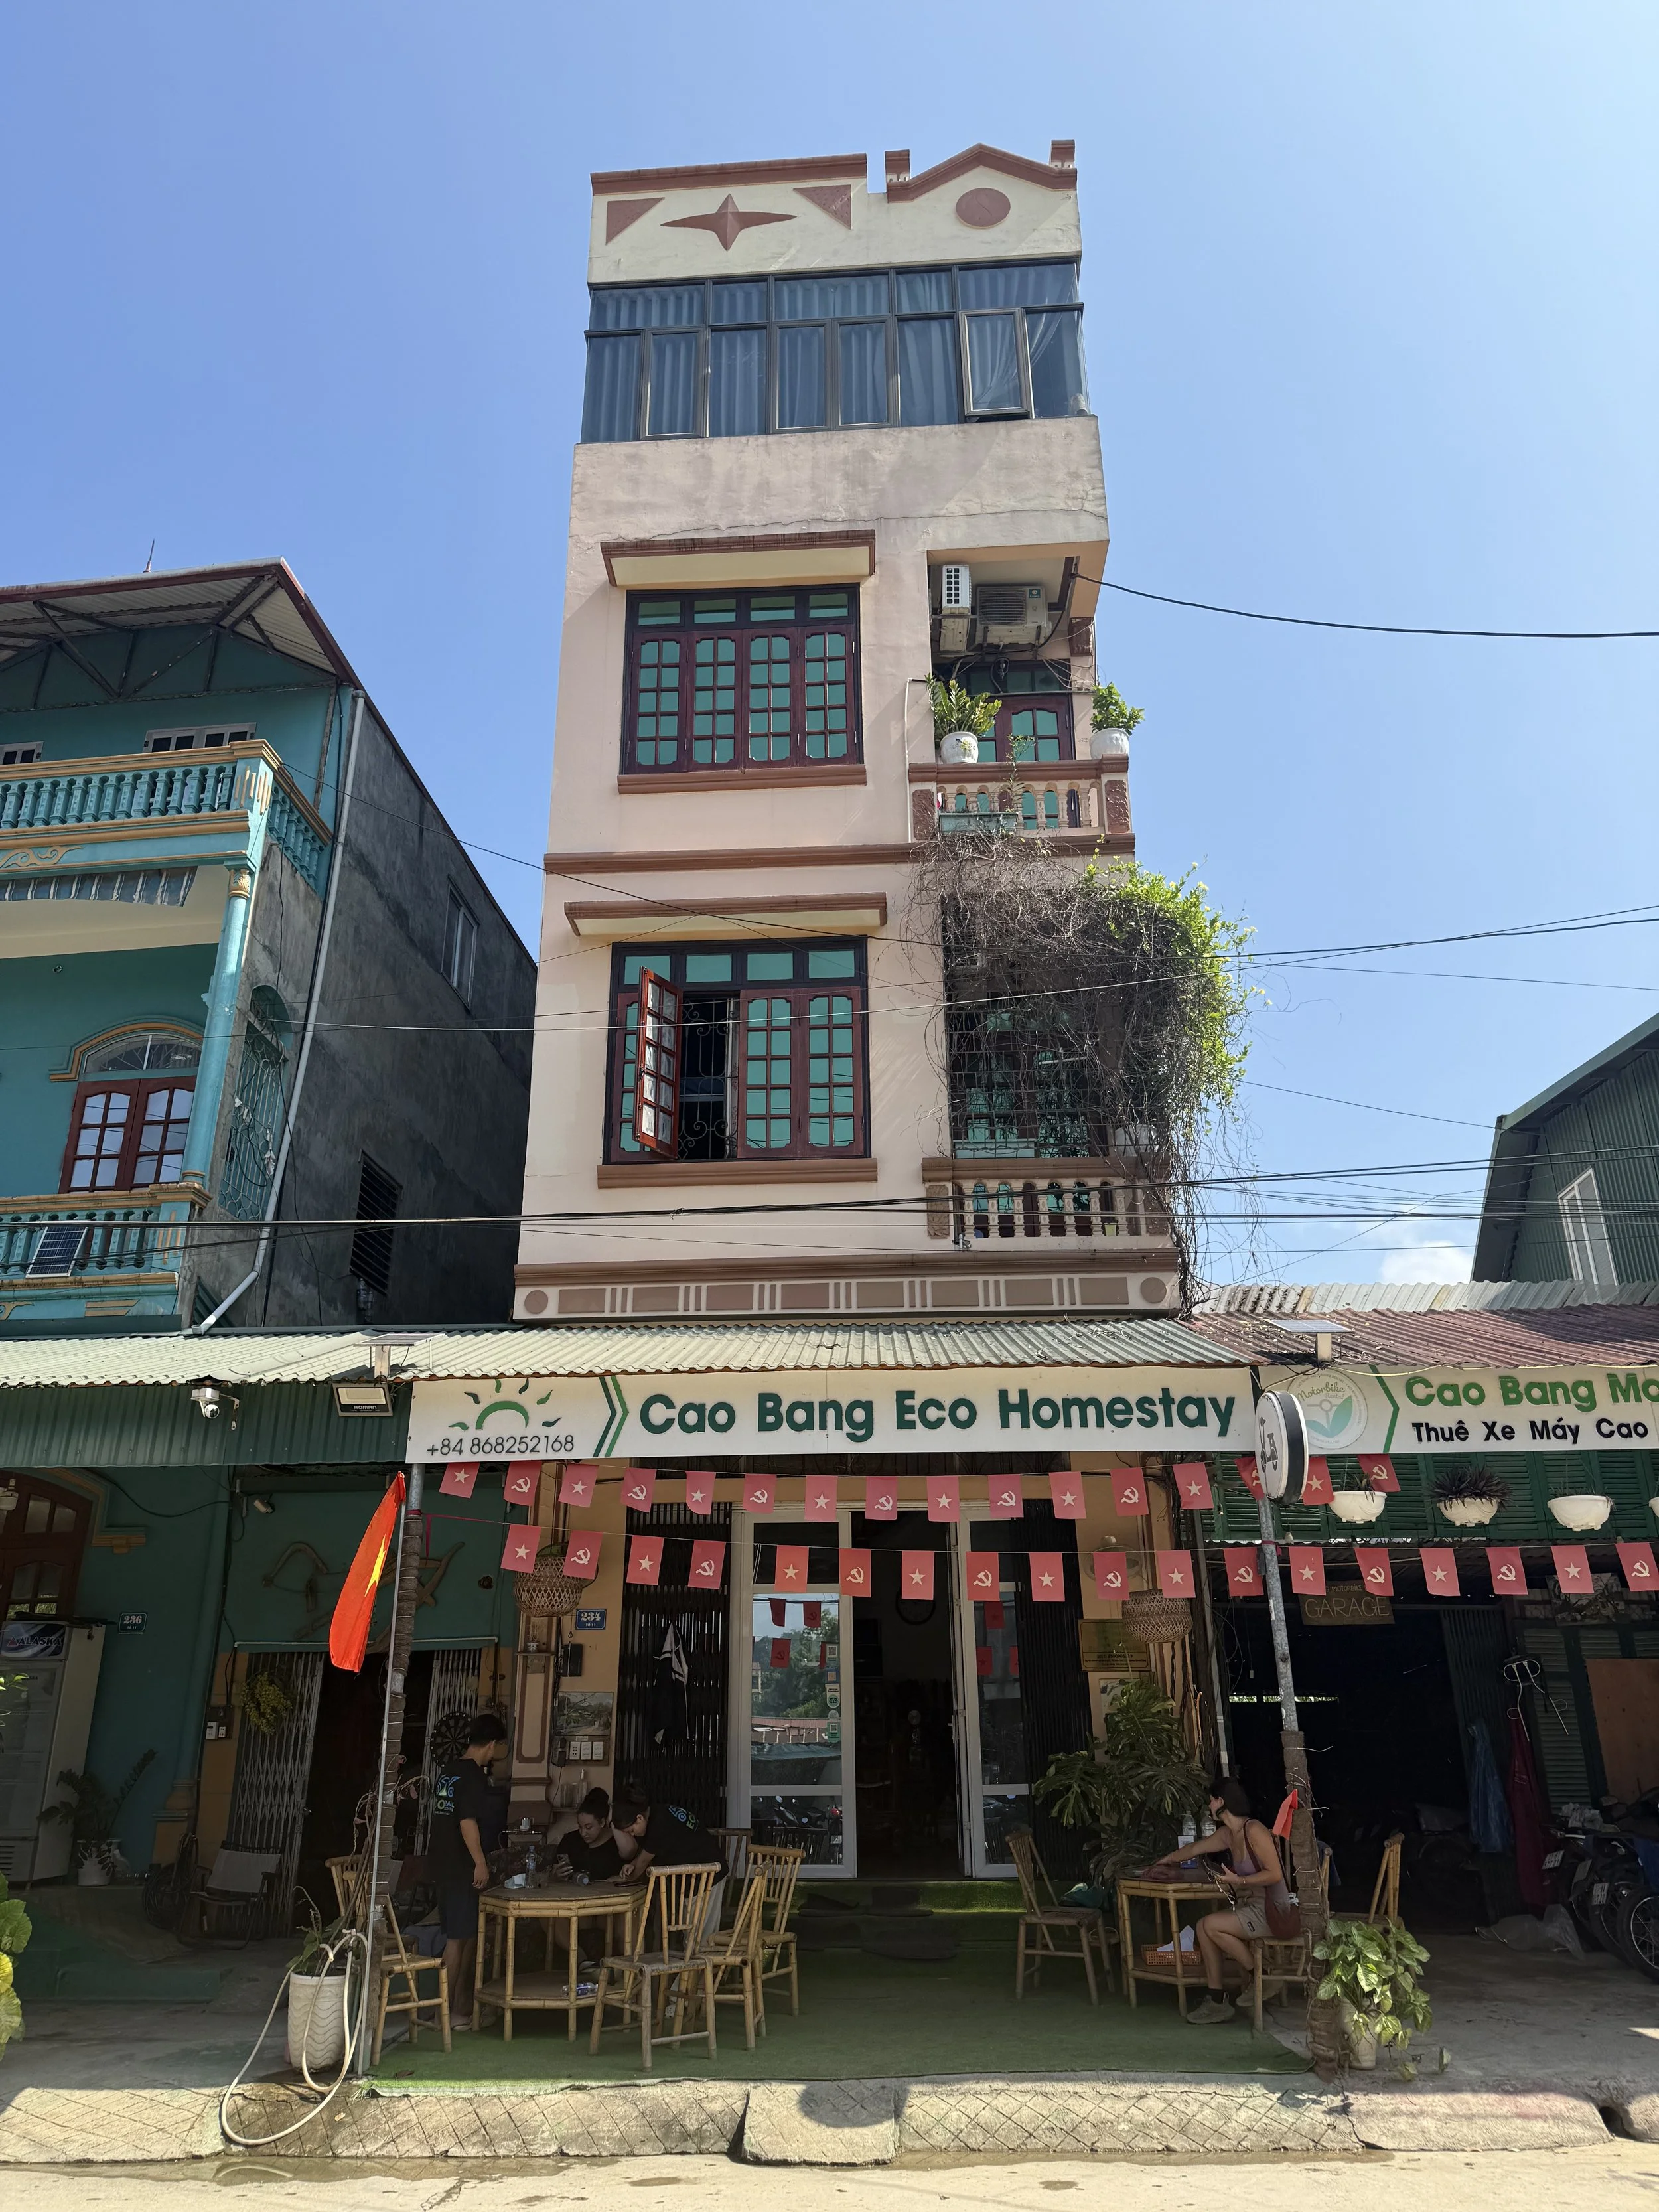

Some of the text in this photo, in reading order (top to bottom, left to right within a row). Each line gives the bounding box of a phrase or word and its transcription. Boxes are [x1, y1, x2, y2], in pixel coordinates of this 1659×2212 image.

[1295, 1382, 1345, 1404] Motorbike
[1405, 1376, 1485, 1407] Cao
[1498, 1376, 1597, 1412] Bang
[639, 1388, 1235, 1443] Cao Bang Eco Homestay
[1412, 1417, 1648, 1444] Thuê Xe Máy Cao
[427, 1435, 575, 1456] +84 868252168
[581, 1611, 601, 1621] 234
[1305, 1597, 1390, 1618] GARAGE
[123, 1615, 143, 1624] 236
[17, 1635, 62, 1647] ALASKA
